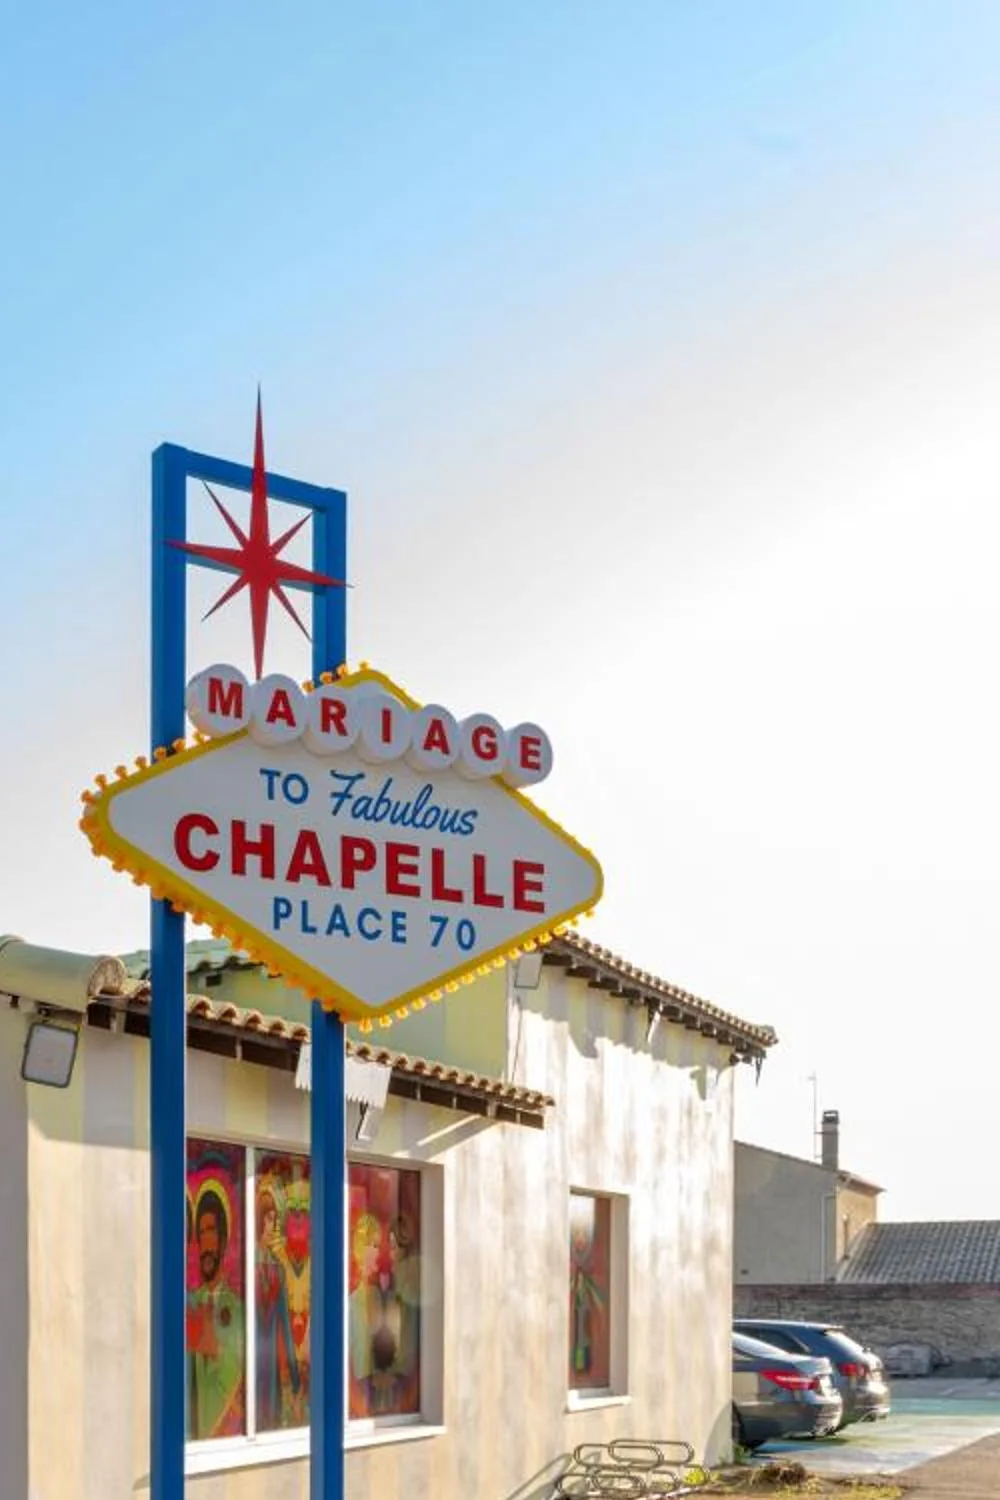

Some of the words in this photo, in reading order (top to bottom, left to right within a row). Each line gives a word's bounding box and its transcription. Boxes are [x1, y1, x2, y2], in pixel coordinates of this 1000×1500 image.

[207, 677, 542, 771] MARIAGE
[260, 767, 310, 806] TO
[329, 769, 478, 836] Fabulous
[173, 813, 546, 914] CHAPELLE
[271, 896, 406, 946] PLACE
[430, 913, 477, 954] 70
